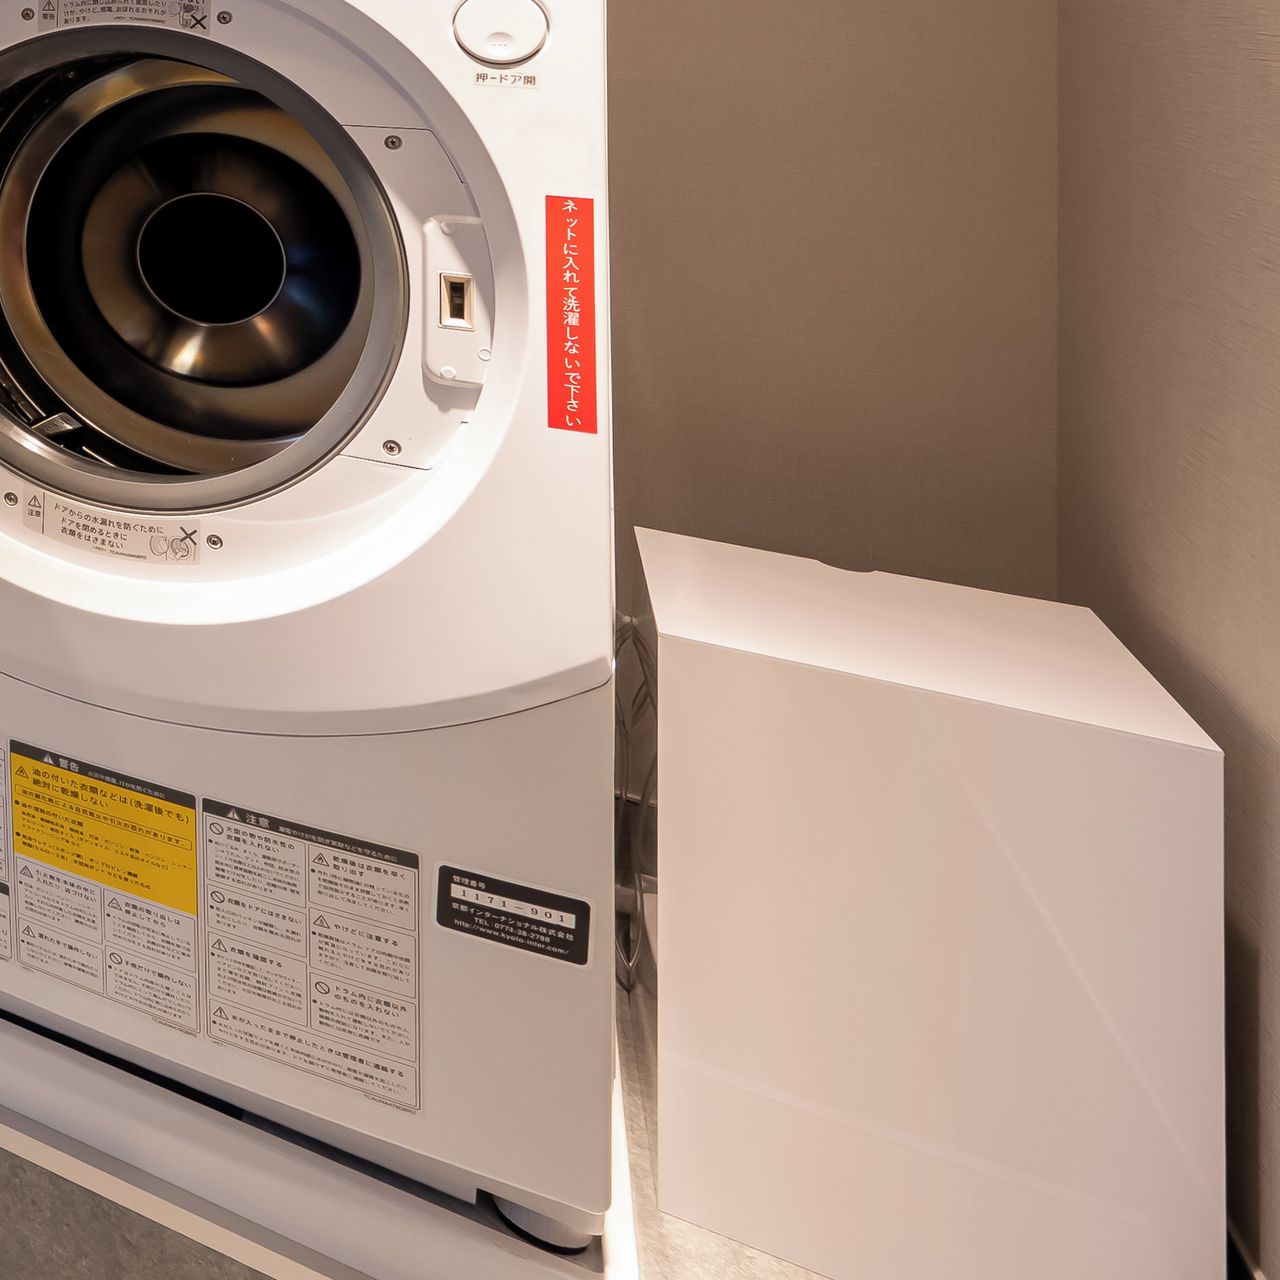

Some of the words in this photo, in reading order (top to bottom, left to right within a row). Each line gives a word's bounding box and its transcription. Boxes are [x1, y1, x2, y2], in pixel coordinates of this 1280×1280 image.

[562, 200, 581, 426] ネットに入れて洗濯しないで下さい
[28, 509, 41, 517] 注意
[54, 503, 164, 533] ドアからの水漏れを防ぐために
[61, 517, 127, 541] ドアを閉めるときに
[61, 527, 124, 549] 衣類をはさまない
[59, 758, 80, 772] 警告
[33, 779, 109, 808] 絶対に乾燥しない
[246, 815, 270, 829] 注意
[227, 834, 279, 853] 衣類を入れない
[333, 856, 407, 880] 乾燥後は衣類を早く
[333, 864, 364, 877] 取り出す
[453, 875, 485, 889] 管理番号
[228, 898, 302, 924] 衣類をドアにはさまない
[452, 903, 574, 941] 京都インターナショナル株式会社
[334, 924, 398, 947] やけどに注意する
[335, 994, 399, 1017] のものを入れない
